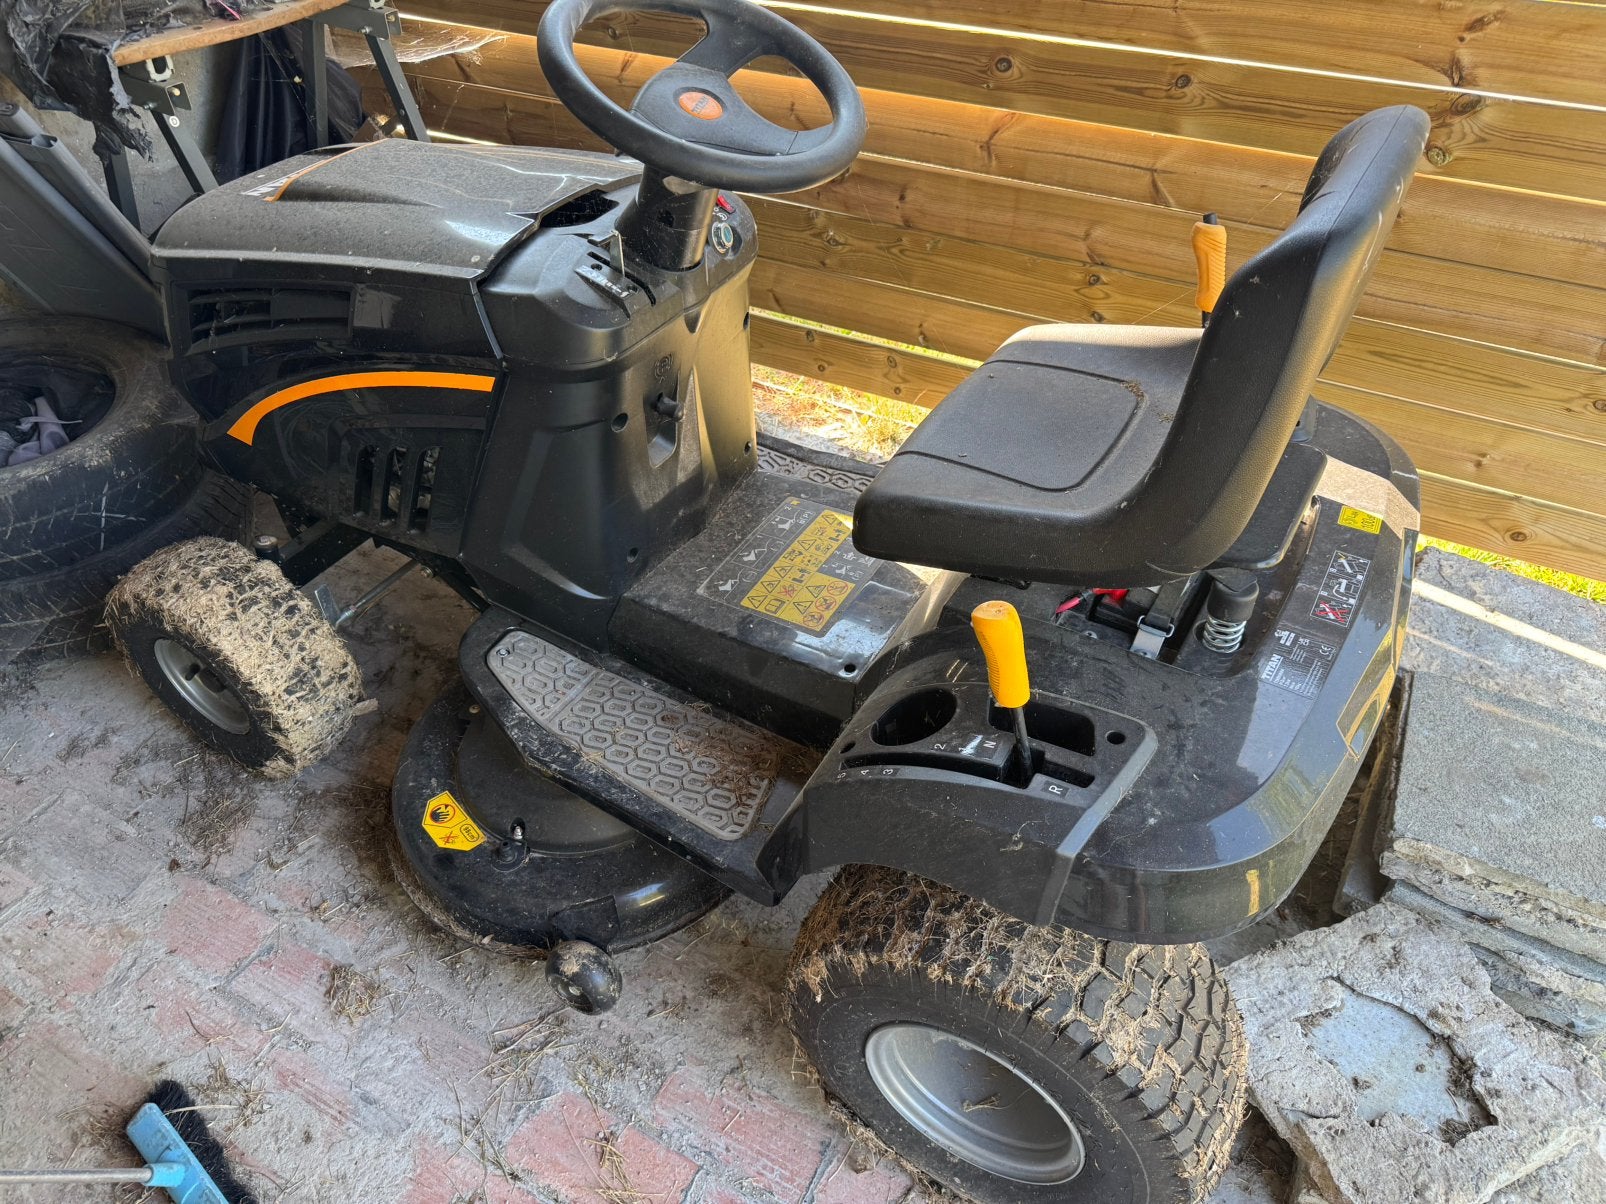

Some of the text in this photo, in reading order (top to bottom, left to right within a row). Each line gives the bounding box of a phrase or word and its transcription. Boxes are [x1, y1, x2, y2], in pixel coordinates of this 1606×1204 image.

[1320, 645, 1331, 655] CE
[1261, 653, 1282, 679] TITAN
[983, 740, 997, 749] N
[1048, 784, 1063, 794] R
